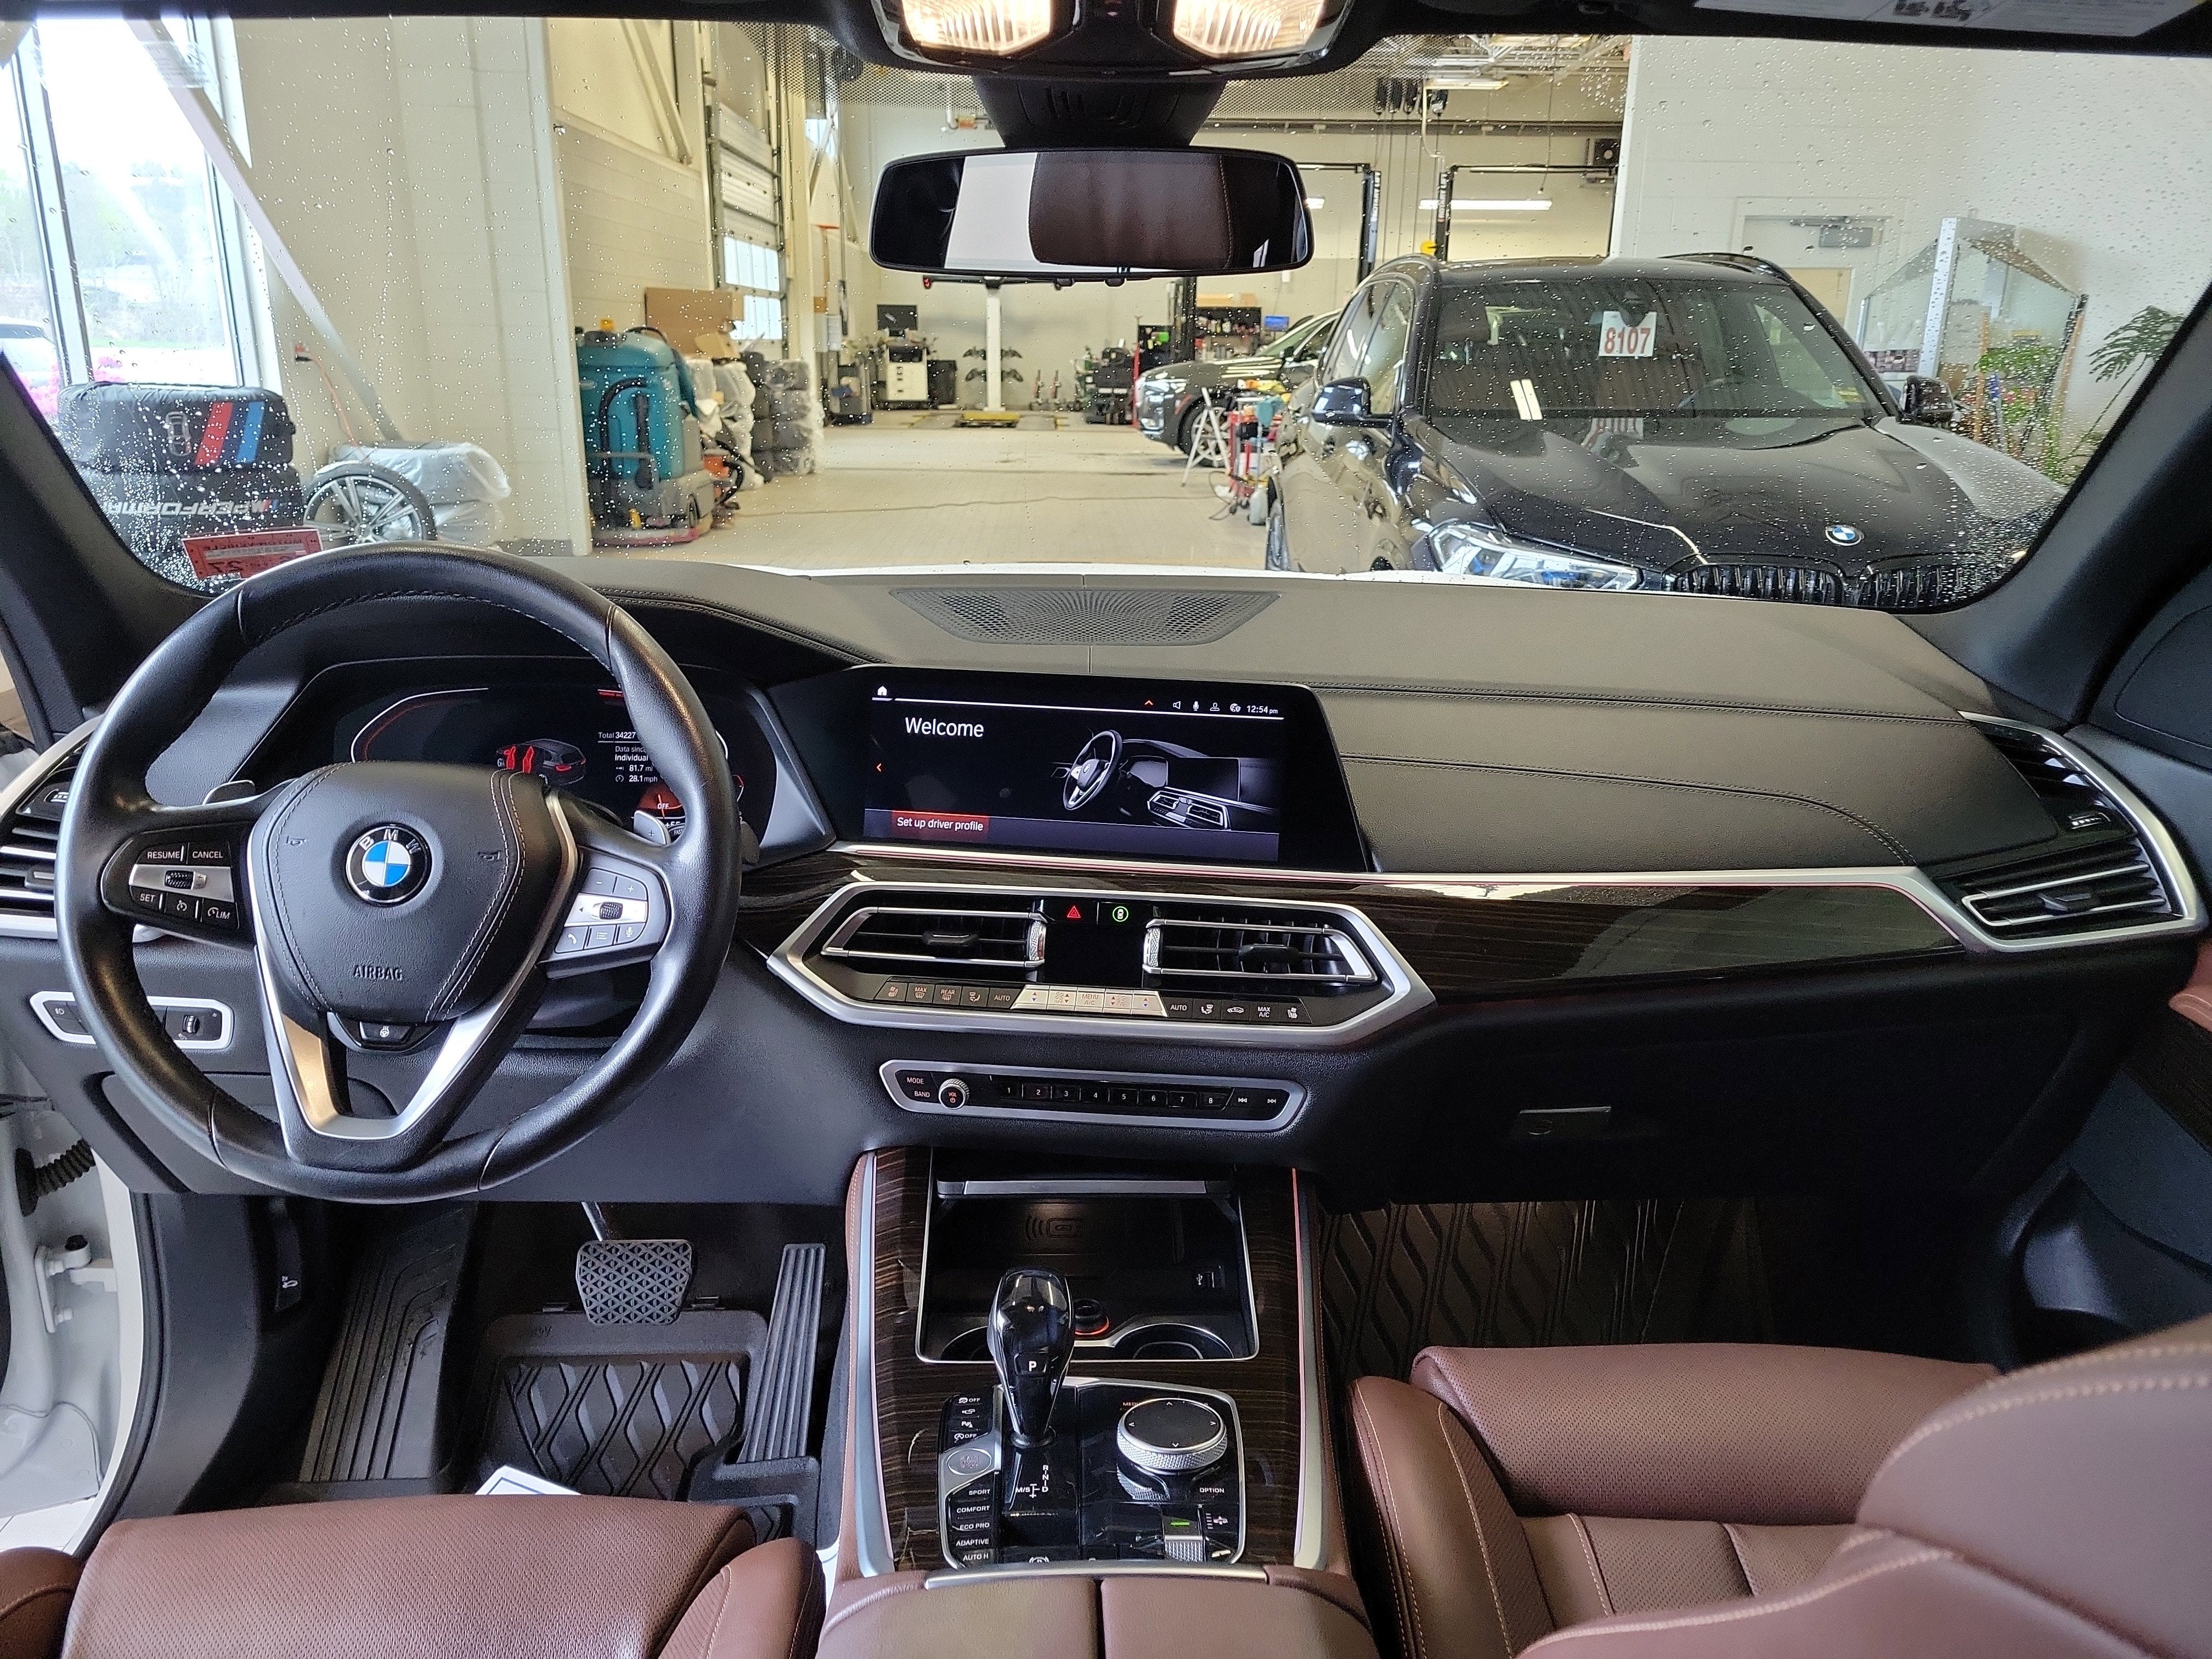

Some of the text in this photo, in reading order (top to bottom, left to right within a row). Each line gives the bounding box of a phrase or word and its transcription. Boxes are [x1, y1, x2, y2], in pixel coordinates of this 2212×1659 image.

[1604, 327, 1651, 354] 8107
[1246, 705, 1268, 714] 12:54
[905, 717, 984, 737] Welcome
[897, 817, 984, 831] Set up driver profile
[359, 828, 421, 855] BMW
[147, 851, 180, 859] RESUME
[140, 893, 156, 902] SET
[216, 911, 230, 919] LIM
[353, 965, 403, 981] AIRBAG
[1029, 1360, 1037, 1372] P
[956, 1505, 990, 1514] COMFORT
[955, 1538, 990, 1547] ADAPTIVE
[962, 1553, 982, 1561] AUTO
